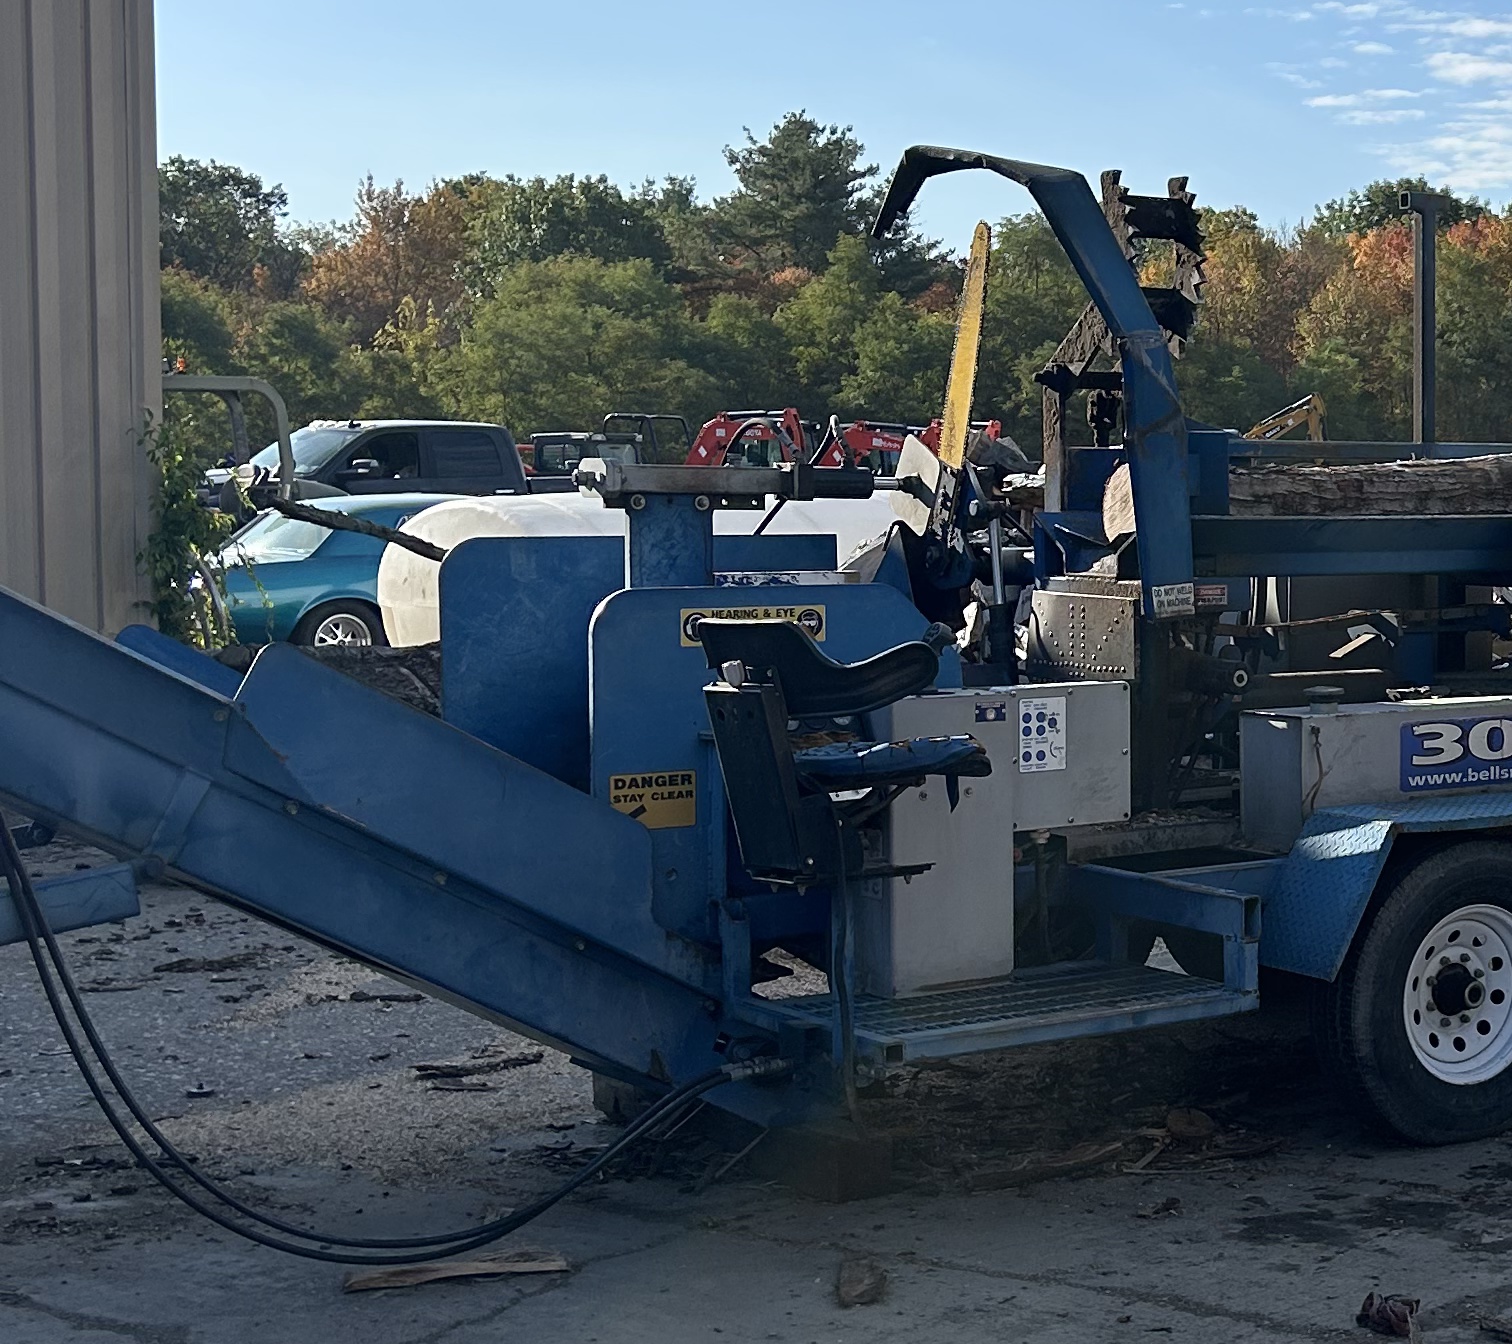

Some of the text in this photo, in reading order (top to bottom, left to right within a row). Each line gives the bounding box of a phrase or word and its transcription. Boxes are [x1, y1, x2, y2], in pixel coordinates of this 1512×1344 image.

[711, 608, 796, 619] HEARING & EYE
[613, 774, 693, 790] DANGER
[613, 789, 694, 804] STAY CLEAR
